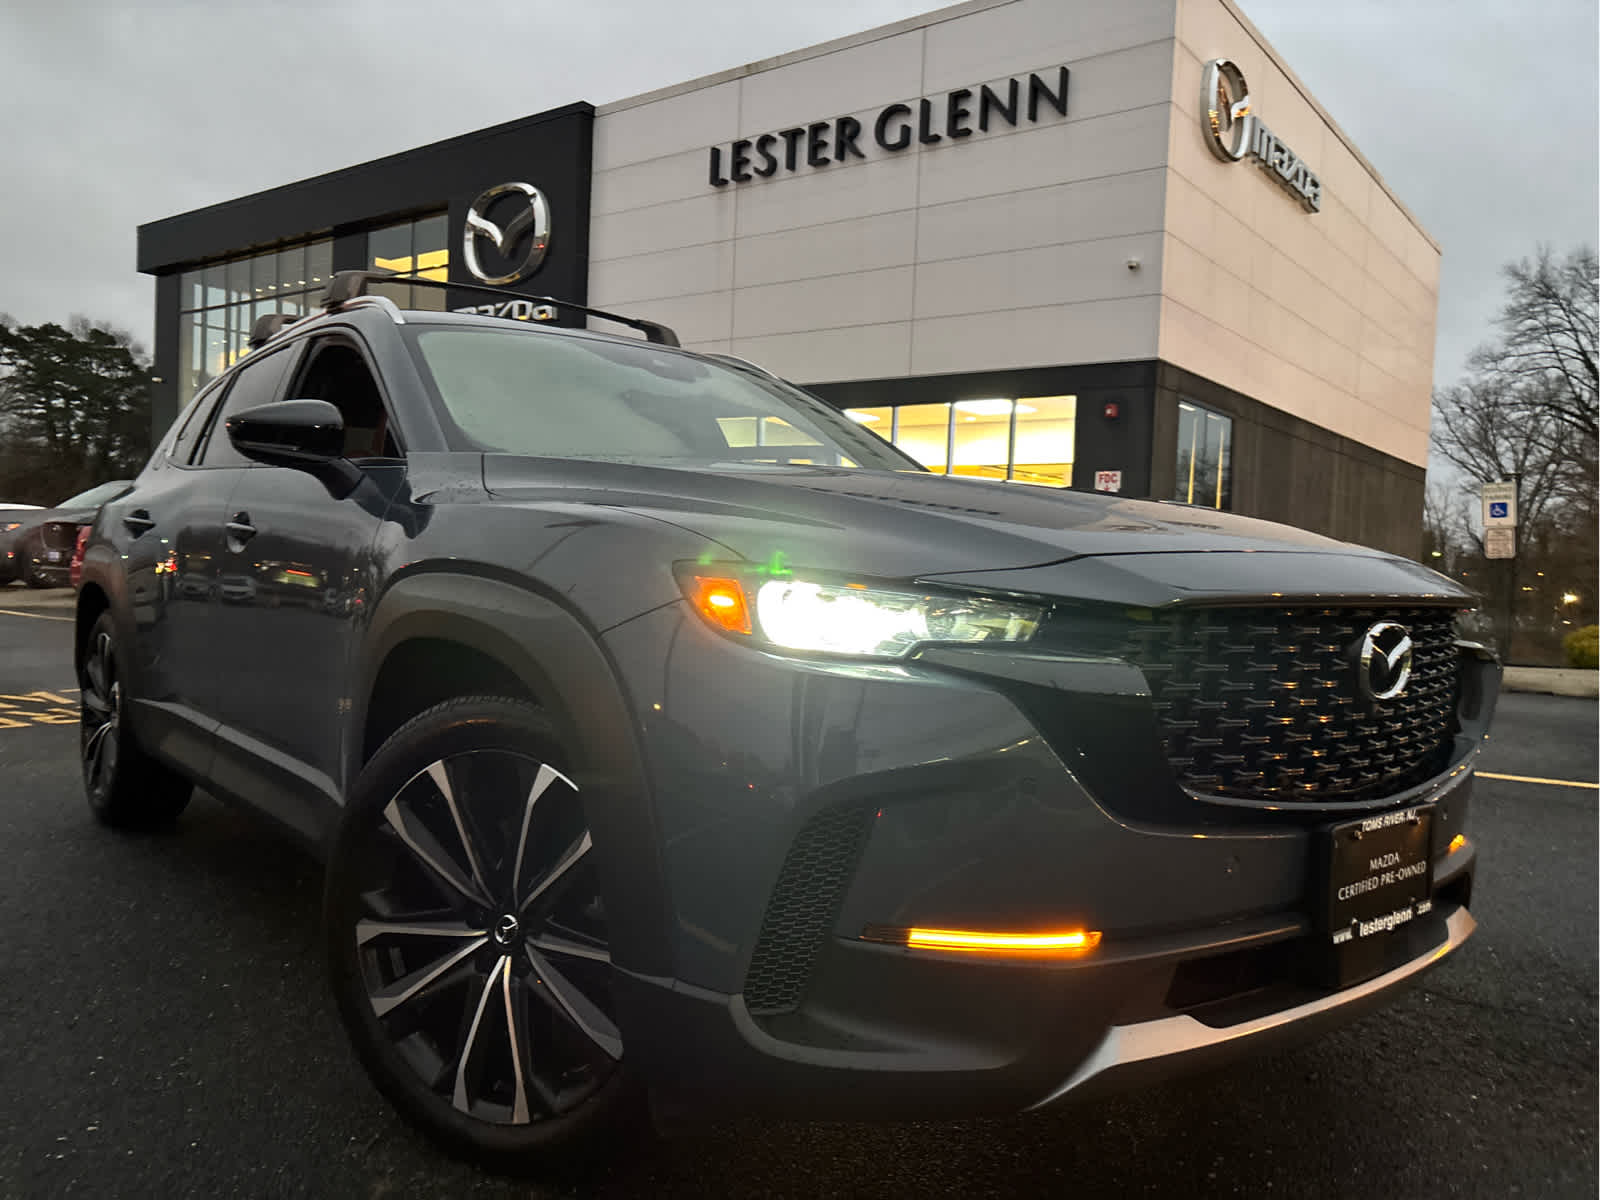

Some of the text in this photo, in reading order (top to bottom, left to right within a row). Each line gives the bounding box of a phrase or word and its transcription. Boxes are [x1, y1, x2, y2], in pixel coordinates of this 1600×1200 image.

[709, 66, 1070, 187] LESTER GLENN
[1098, 473, 1118, 484] FDC
[1362, 816, 1383, 832] TOMS
[1369, 852, 1400, 871] MAZDA
[1337, 861, 1427, 901] CERTIFIED PRE-OWNED
[1359, 907, 1413, 937] lesterglenn
